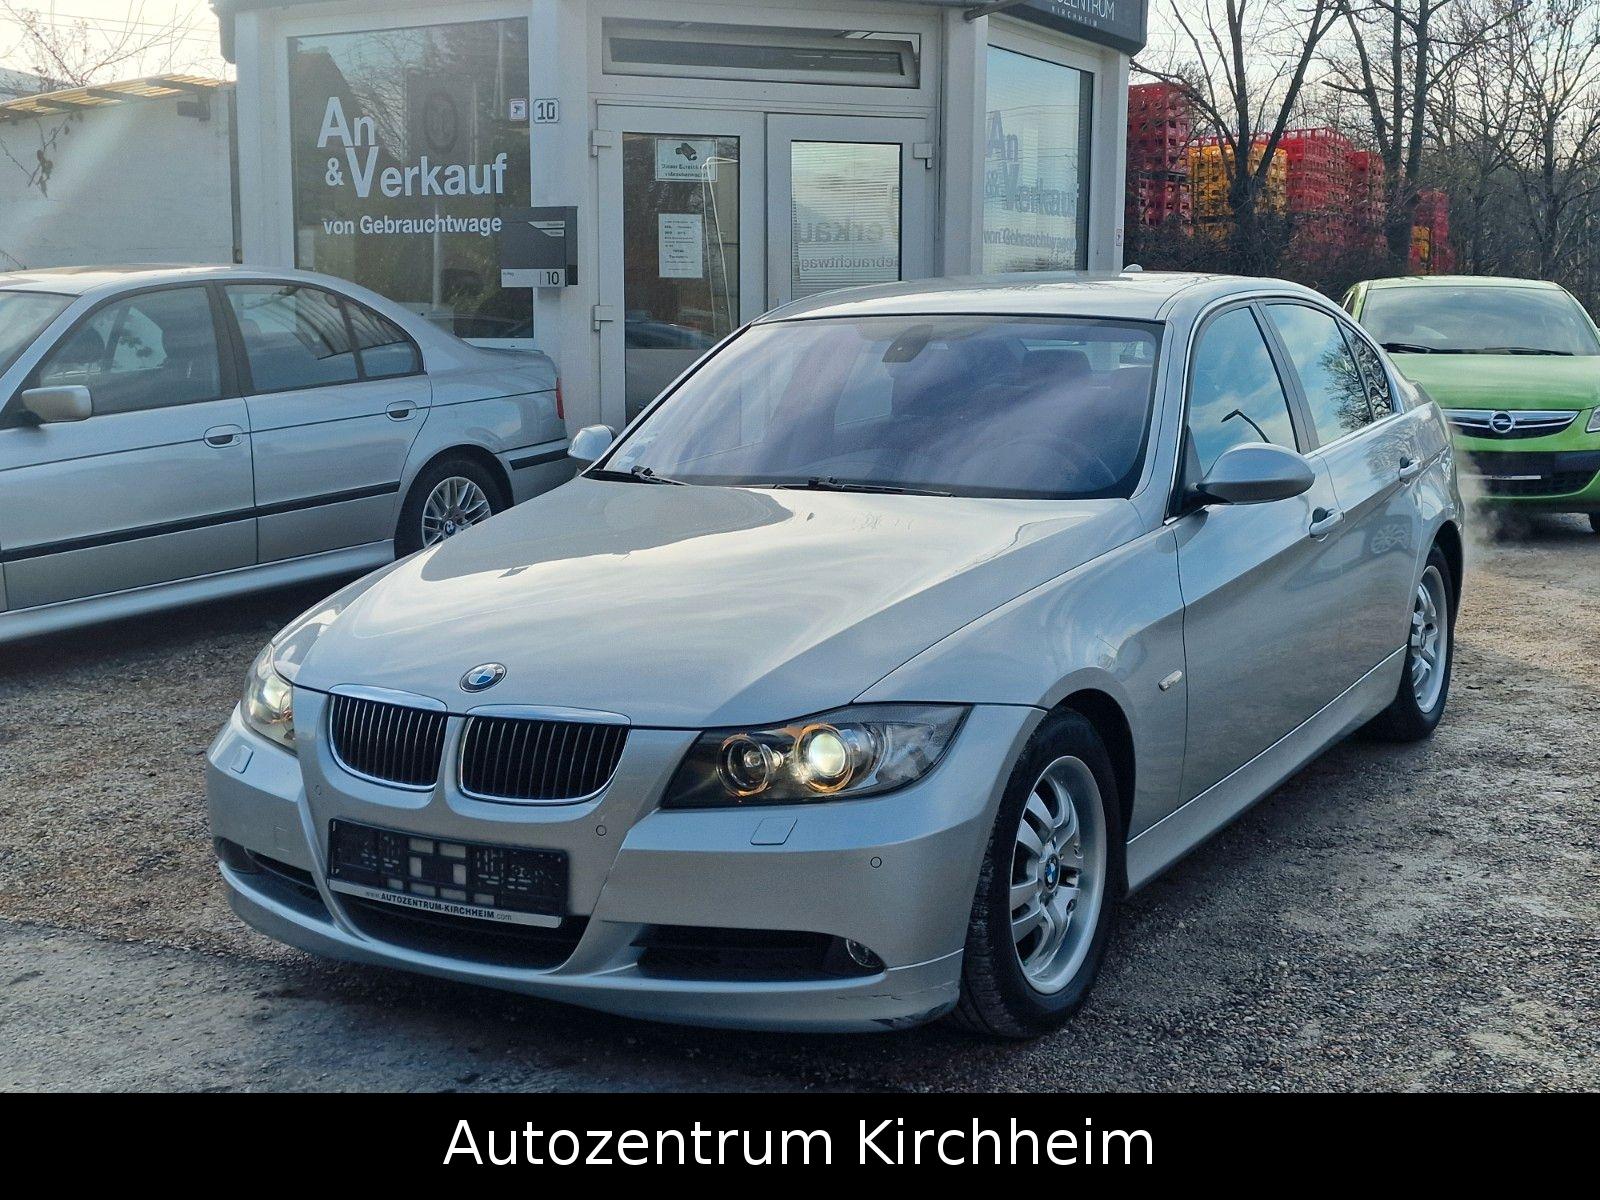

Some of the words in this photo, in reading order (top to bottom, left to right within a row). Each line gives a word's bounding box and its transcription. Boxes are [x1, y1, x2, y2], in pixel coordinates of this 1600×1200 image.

[1058, 0, 1115, 20] NTRUM
[537, 102, 556, 120] 10
[317, 96, 376, 148] An
[325, 157, 345, 186] &
[345, 145, 508, 198] Verkauf
[323, 219, 355, 235] von
[546, 271, 560, 285] 10
